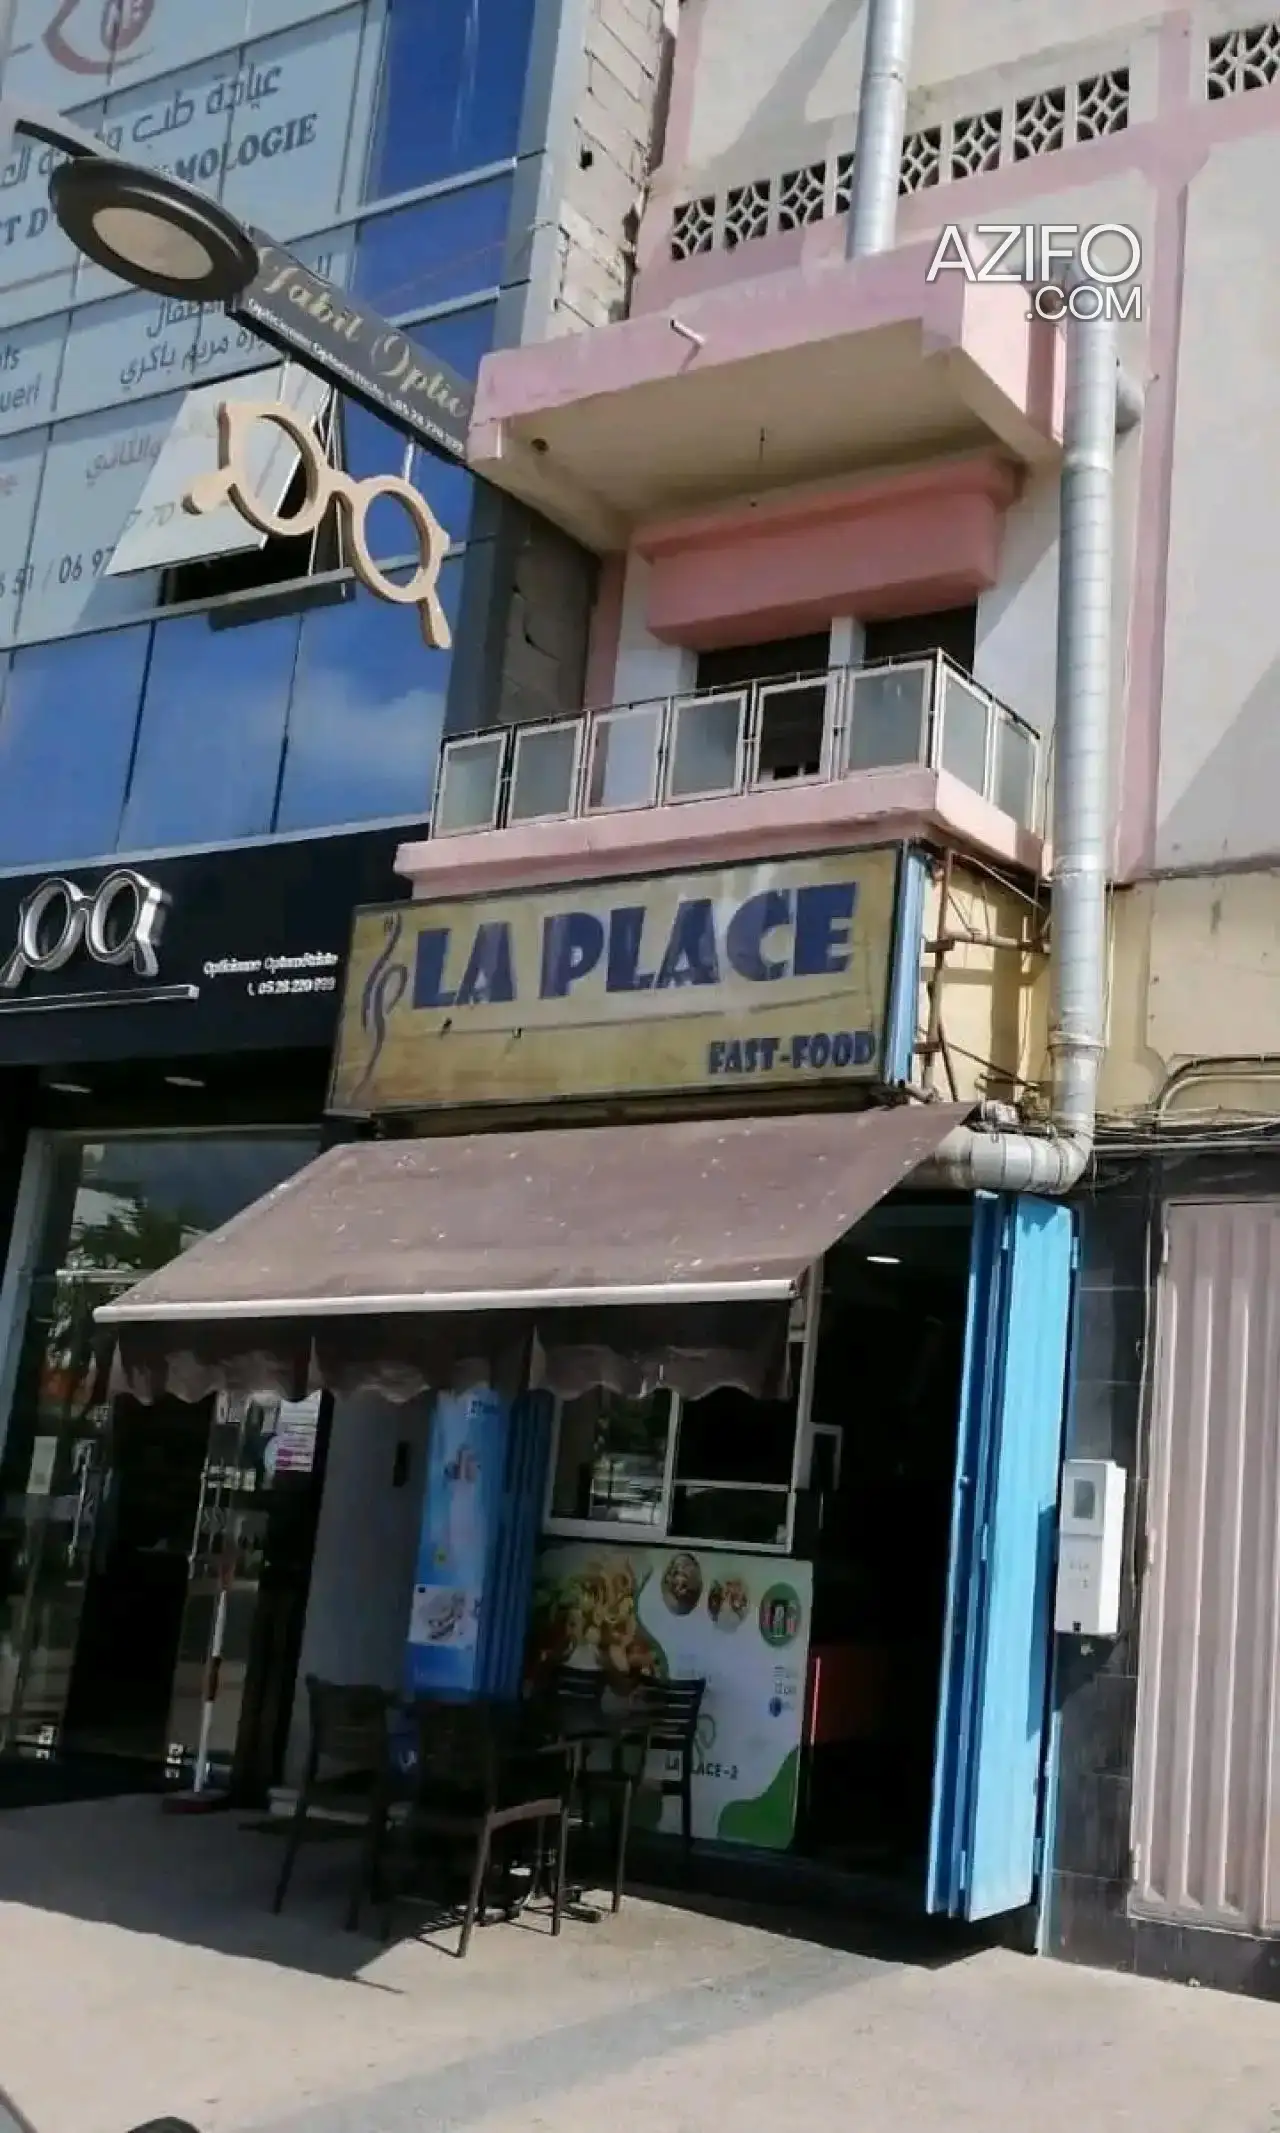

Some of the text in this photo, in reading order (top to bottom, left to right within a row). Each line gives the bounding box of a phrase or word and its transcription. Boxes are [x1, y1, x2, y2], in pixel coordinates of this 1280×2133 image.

[371, 332, 470, 419] Optic
[413, 880, 857, 1009] LA PLACE
[708, 1030, 876, 1075] FAST-FOOD
